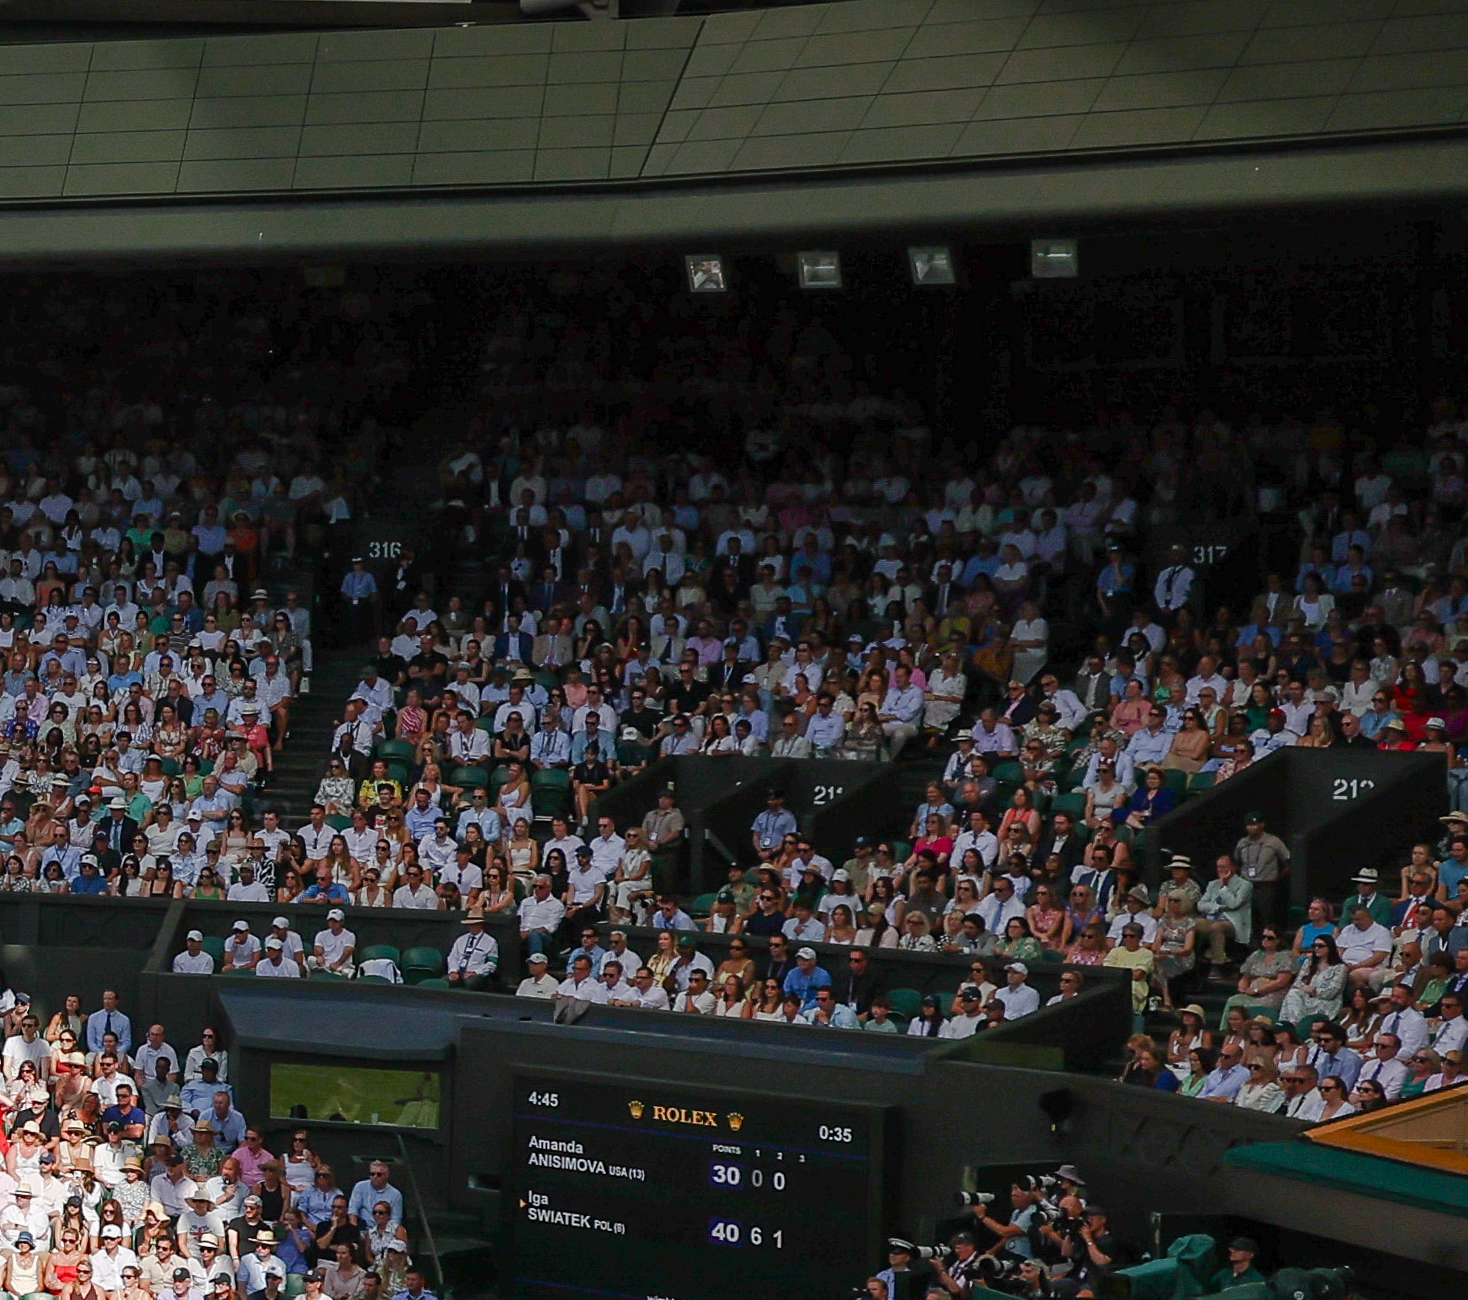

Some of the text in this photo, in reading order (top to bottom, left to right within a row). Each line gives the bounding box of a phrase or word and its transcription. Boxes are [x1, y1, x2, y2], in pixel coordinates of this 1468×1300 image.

[369, 541, 402, 559] 316
[528, 1091, 559, 1107] 4:45
[652, 1105, 717, 1127] ROLEX
[819, 1125, 853, 1143] 0:35
[528, 1135, 584, 1155] Amanda
[712, 1144, 742, 1155] POINTS
[777, 1152, 783, 1160] 2
[799, 1155, 805, 1163] 3
[528, 1153, 646, 1181] ANISIMOVA USA (13)
[712, 1165, 785, 1190] 30 0 0
[528, 1190, 549, 1207] Iga
[528, 1207, 591, 1229] SWIATEK
[594, 1219, 613, 1231] POL
[711, 1223, 783, 1249] 40 6 1
